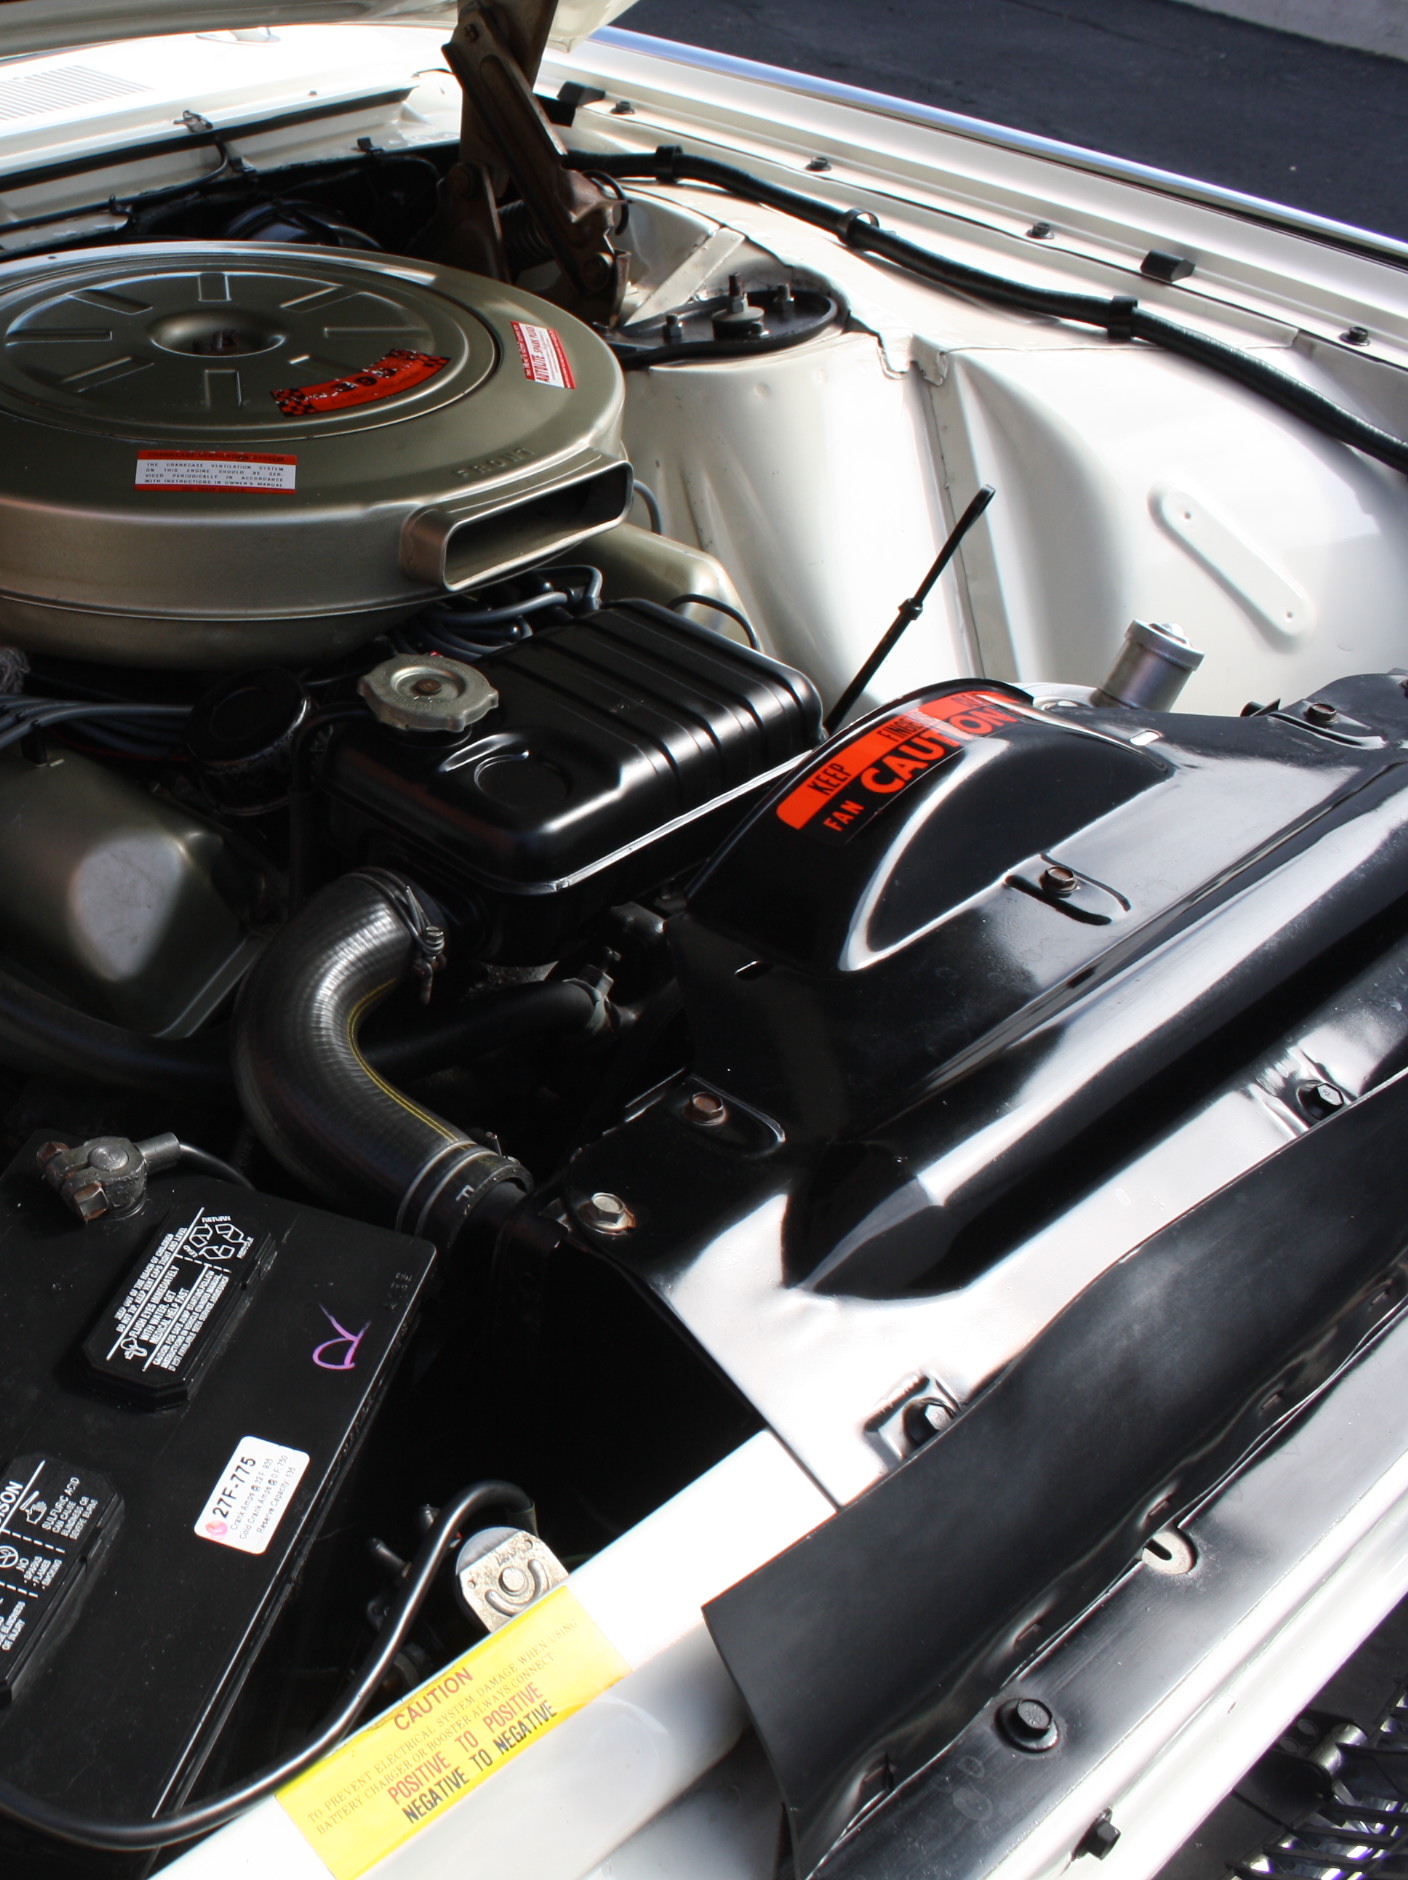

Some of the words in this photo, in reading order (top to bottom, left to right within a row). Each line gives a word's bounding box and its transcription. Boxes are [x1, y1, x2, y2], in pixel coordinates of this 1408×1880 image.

[860, 706, 1019, 794] CAUTION
[808, 762, 852, 796] KEEP
[823, 799, 865, 832] FAN
[114, 1307, 126, 1320] KEEP
[123, 1296, 134, 1306] OUT
[134, 1279, 145, 1289] THE
[140, 1263, 155, 1280] REACH
[150, 1256, 159, 1264] OF
[116, 1324, 126, 1332] DO
[121, 1312, 132, 1324] NOT
[134, 1290, 146, 1303] KEEP
[142, 1277, 154, 1290] VENT
[150, 1265, 163, 1278] CAPS
[158, 1251, 172, 1265] TIGHT
[167, 1240, 178, 1251] AND
[129, 1318, 147, 1338] FLUSH
[140, 1303, 156, 1319] EYES
[150, 1265, 179, 1304] IMMEDIATELY
[139, 1324, 155, 1341] WITH
[164, 1290, 176, 1302] GET
[149, 1318, 171, 1344] MEDICAL
[165, 1302, 180, 1319] HELP
[174, 1288, 189, 1303] FAST
[42, 1495, 69, 1530] SULFURIC
[64, 1476, 80, 1496] ACID
[212, 1456, 256, 1518] 27F-775
[52, 1520, 64, 1533] CAN
[60, 1501, 76, 1520] CAUSE
[60, 1506, 84, 1536] BLINDNESS
[80, 1496, 89, 1506] OR
[16, 1558, 29, 1572] NO
[24, 1556, 42, 1580] SPARKS
[32, 1560, 51, 1583] FLAMES
[39, 1559, 62, 1586] SMOKING
[0, 1638, 13, 1650] OR
[6, 1619, 25, 1641] INJURY
[391, 1666, 474, 1732] CAUTION
[307, 1808, 324, 1824] TO
[323, 1770, 374, 1811] PREVENT
[372, 1723, 436, 1774] ELECTRICAL
[434, 1693, 476, 1728] SYSTEM
[475, 1661, 519, 1698] DAMAGE
[516, 1639, 548, 1666] WHEN
[386, 1750, 451, 1806] POSITIVE
[453, 1728, 480, 1755] TO
[481, 1680, 544, 1734] POSITIVE
[316, 1794, 364, 1836] BATTERY
[362, 1758, 413, 1800] CHARGER
[410, 1746, 428, 1763] OR
[425, 1713, 472, 1752] BOOSTER
[470, 1683, 512, 1718] ALWAYS
[401, 1765, 471, 1825] NEGATIVE
[468, 1746, 495, 1773] TO
[491, 1697, 558, 1756] NEGATIVE
